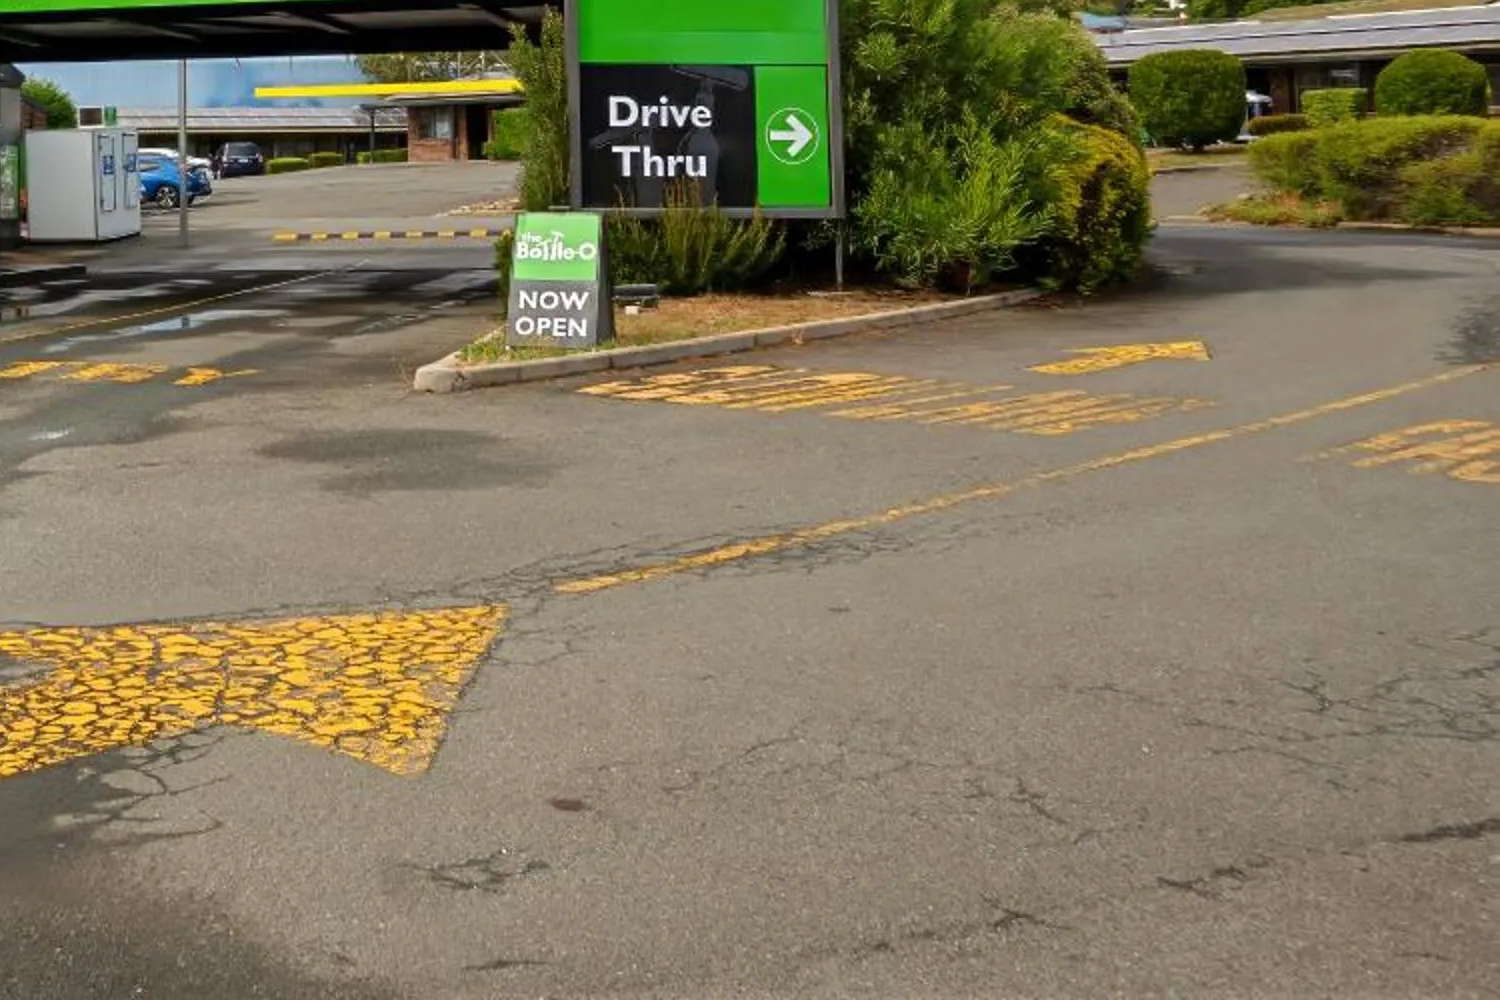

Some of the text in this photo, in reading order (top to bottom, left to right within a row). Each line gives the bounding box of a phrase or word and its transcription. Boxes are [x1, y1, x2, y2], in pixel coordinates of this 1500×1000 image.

[608, 95, 713, 128] Drive
[611, 146, 708, 177] Thru
[521, 231, 541, 243] the
[518, 290, 589, 310] NOW
[515, 317, 588, 337] OPEN
